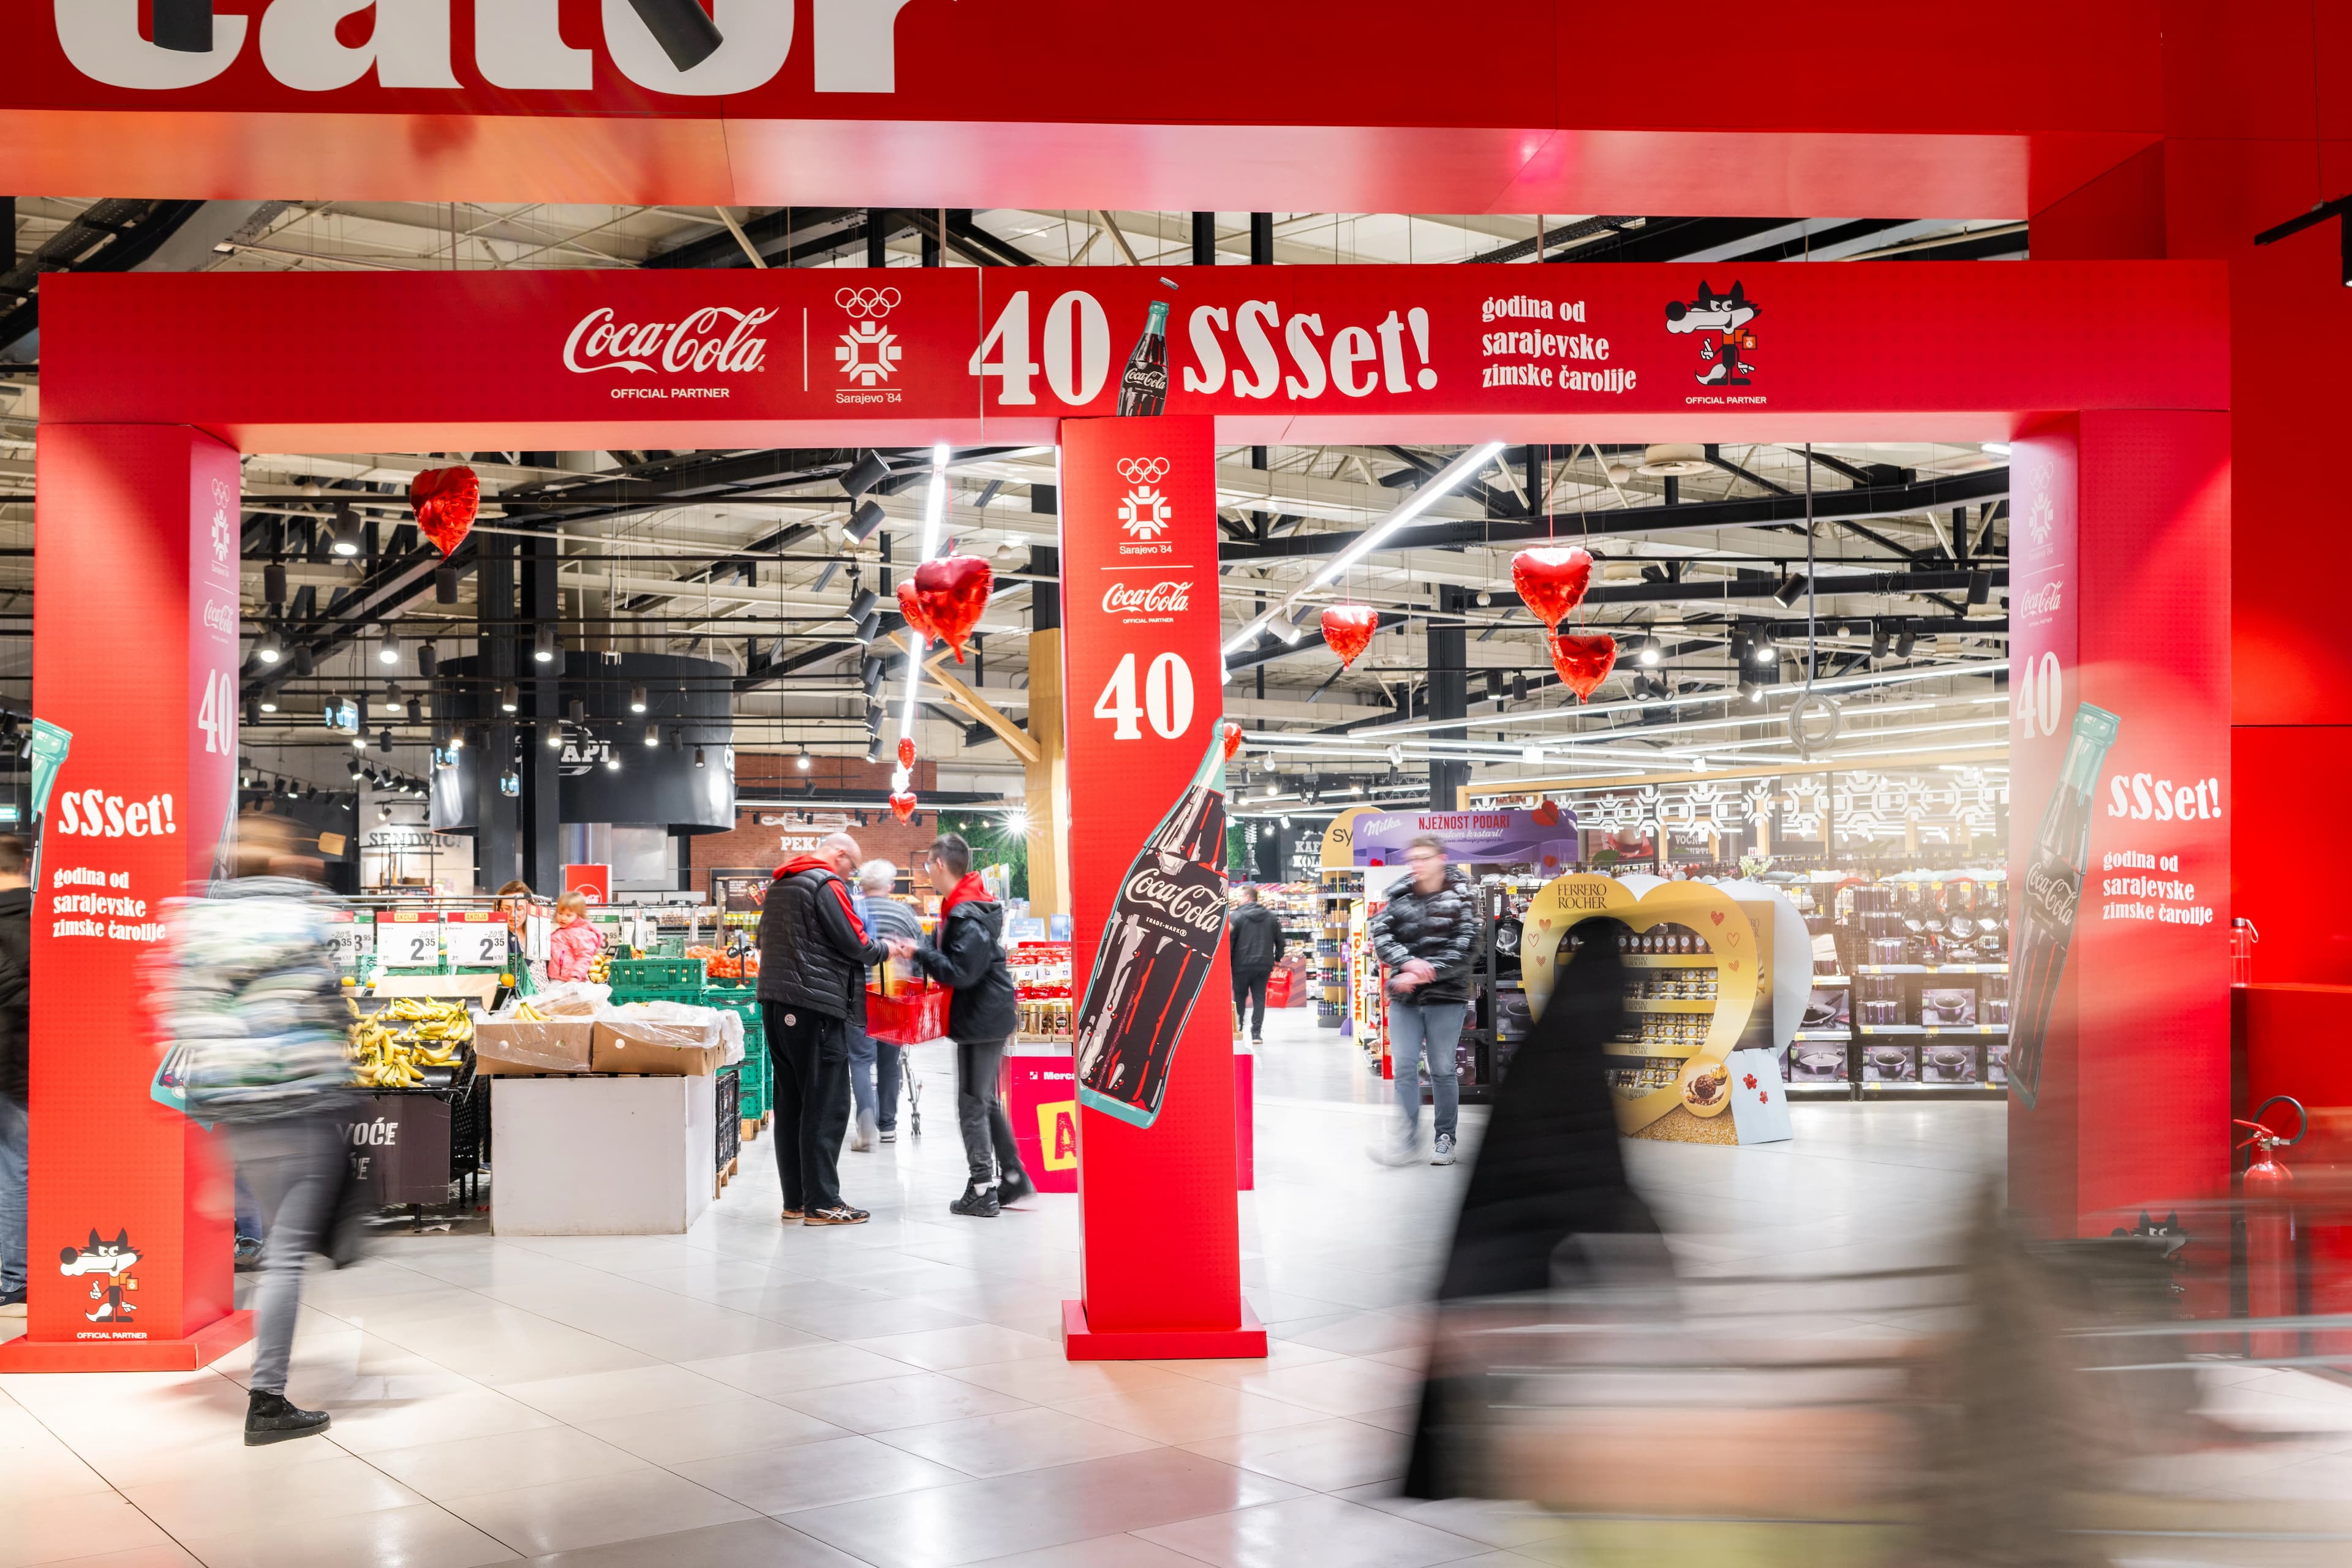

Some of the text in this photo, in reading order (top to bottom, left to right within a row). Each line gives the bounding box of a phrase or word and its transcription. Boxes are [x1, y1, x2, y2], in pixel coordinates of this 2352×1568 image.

[1482, 295, 1586, 323] godina od
[969, 290, 1110, 405] 40
[1482, 329, 1610, 360] sarajevske
[1125, 368, 1167, 390] Coca-Cola
[1482, 364, 1637, 394] zimske čarolije
[611, 388, 729, 398] OFFICIAL PARTNER
[836, 393, 883, 404] Sarajevo
[1119, 545, 1158, 556] Sarajevo
[1102, 581, 1194, 613] Coca-Cola
[1094, 652, 1194, 740] 40
[2017, 651, 2062, 739] 40
[197, 669, 233, 756] 40
[1363, 816, 1403, 837] Milka
[1419, 815, 1510, 830] NJEŽNOST PODARI
[2103, 851, 2179, 872] godina od
[53, 867, 129, 889] godina od
[1558, 883, 1607, 896] FERRERO
[2103, 876, 2195, 900] sarajevske
[53, 893, 146, 917] sarajevske
[1125, 868, 1228, 933] Coca-Cola
[1558, 897, 1607, 909] ROCHER
[2026, 862, 2078, 925] Coca-Cola
[2103, 902, 2214, 926] zimske čarolije
[53, 919, 166, 943] zimske čarolije
[410, 938, 424, 961] 2
[424, 938, 435, 946] 35
[480, 938, 494, 961] 2
[494, 938, 505, 946] 35
[1353, 929, 1363, 1022] TOLERONE
